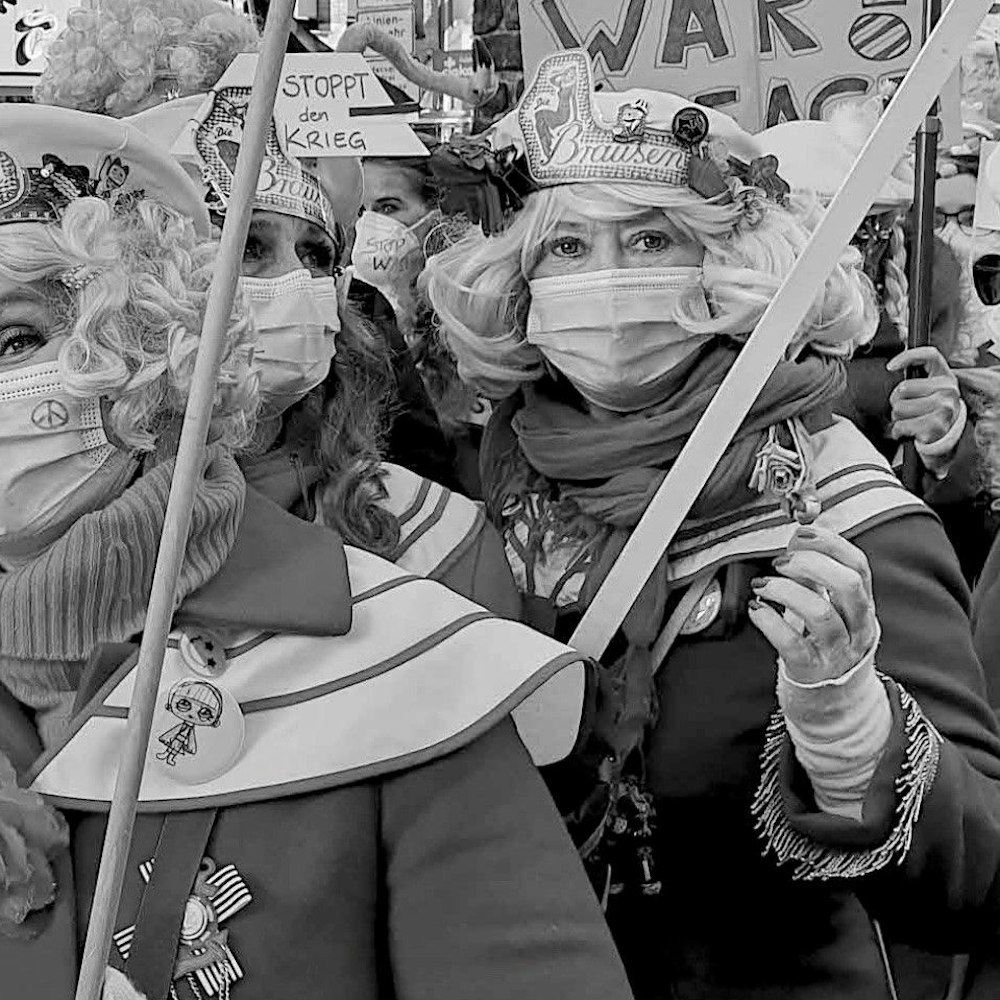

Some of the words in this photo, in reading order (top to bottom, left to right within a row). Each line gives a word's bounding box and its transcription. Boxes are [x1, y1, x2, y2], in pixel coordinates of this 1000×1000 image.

[282, 72, 369, 99] STOPPT
[299, 106, 329, 122] den
[215, 126, 233, 139] Die
[284, 123, 367, 151] KRIEG
[540, 120, 685, 169] Brausen
[361, 237, 405, 254] STOP
